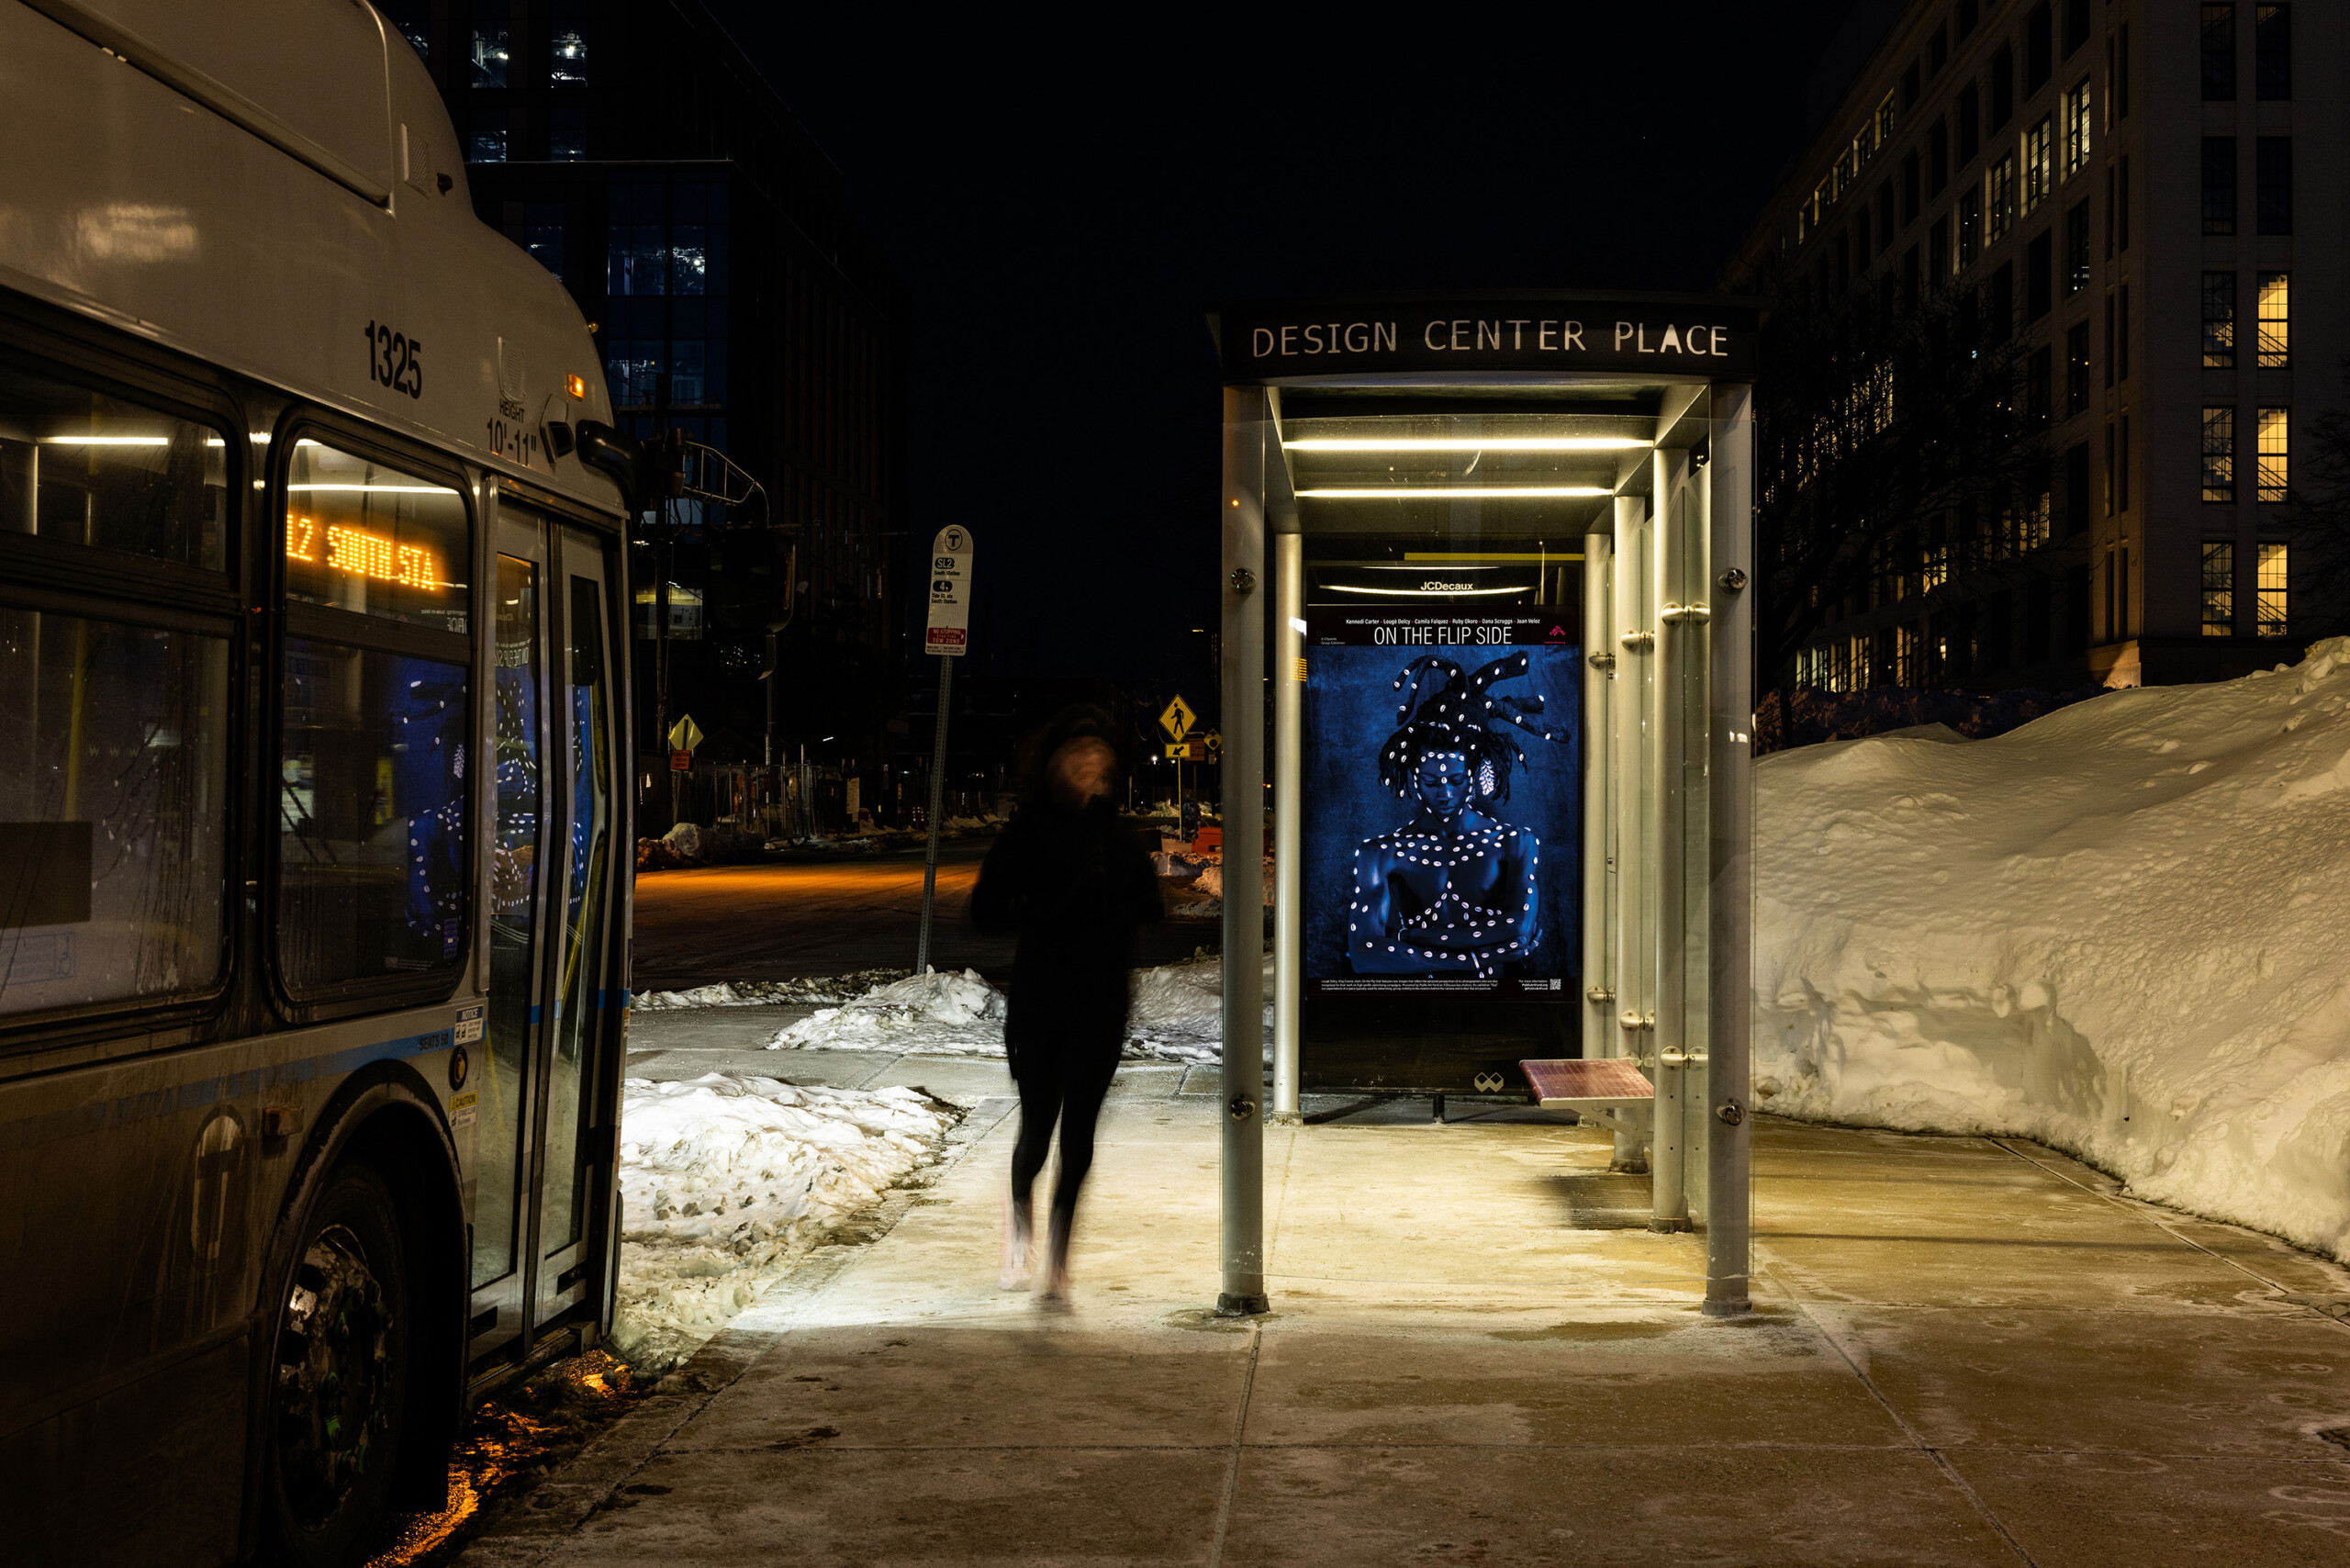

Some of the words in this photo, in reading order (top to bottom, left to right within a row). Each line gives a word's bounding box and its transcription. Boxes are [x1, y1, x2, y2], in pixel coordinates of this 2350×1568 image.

[1253, 321, 1397, 358] DESIGN
[1425, 319, 1587, 353] CENTER
[1615, 321, 1729, 357] PLACE
[365, 319, 422, 399] 1325
[499, 398, 525, 423] HEIGHT
[948, 534, 959, 546] T
[327, 525, 392, 580] SOUTH
[398, 544, 436, 591] STA
[937, 558, 953, 568] SL2
[1420, 581, 1473, 591] JCDecaux
[1374, 626, 1397, 644] ON
[1402, 626, 1433, 644] THE
[1438, 626, 1472, 644] FLIP
[1476, 626, 1512, 644] SIDE
[461, 1007, 479, 1021] NOTICE
[420, 1034, 440, 1050] SEATS
[442, 1033, 449, 1046] 50
[455, 1092, 476, 1108] CAUTION
